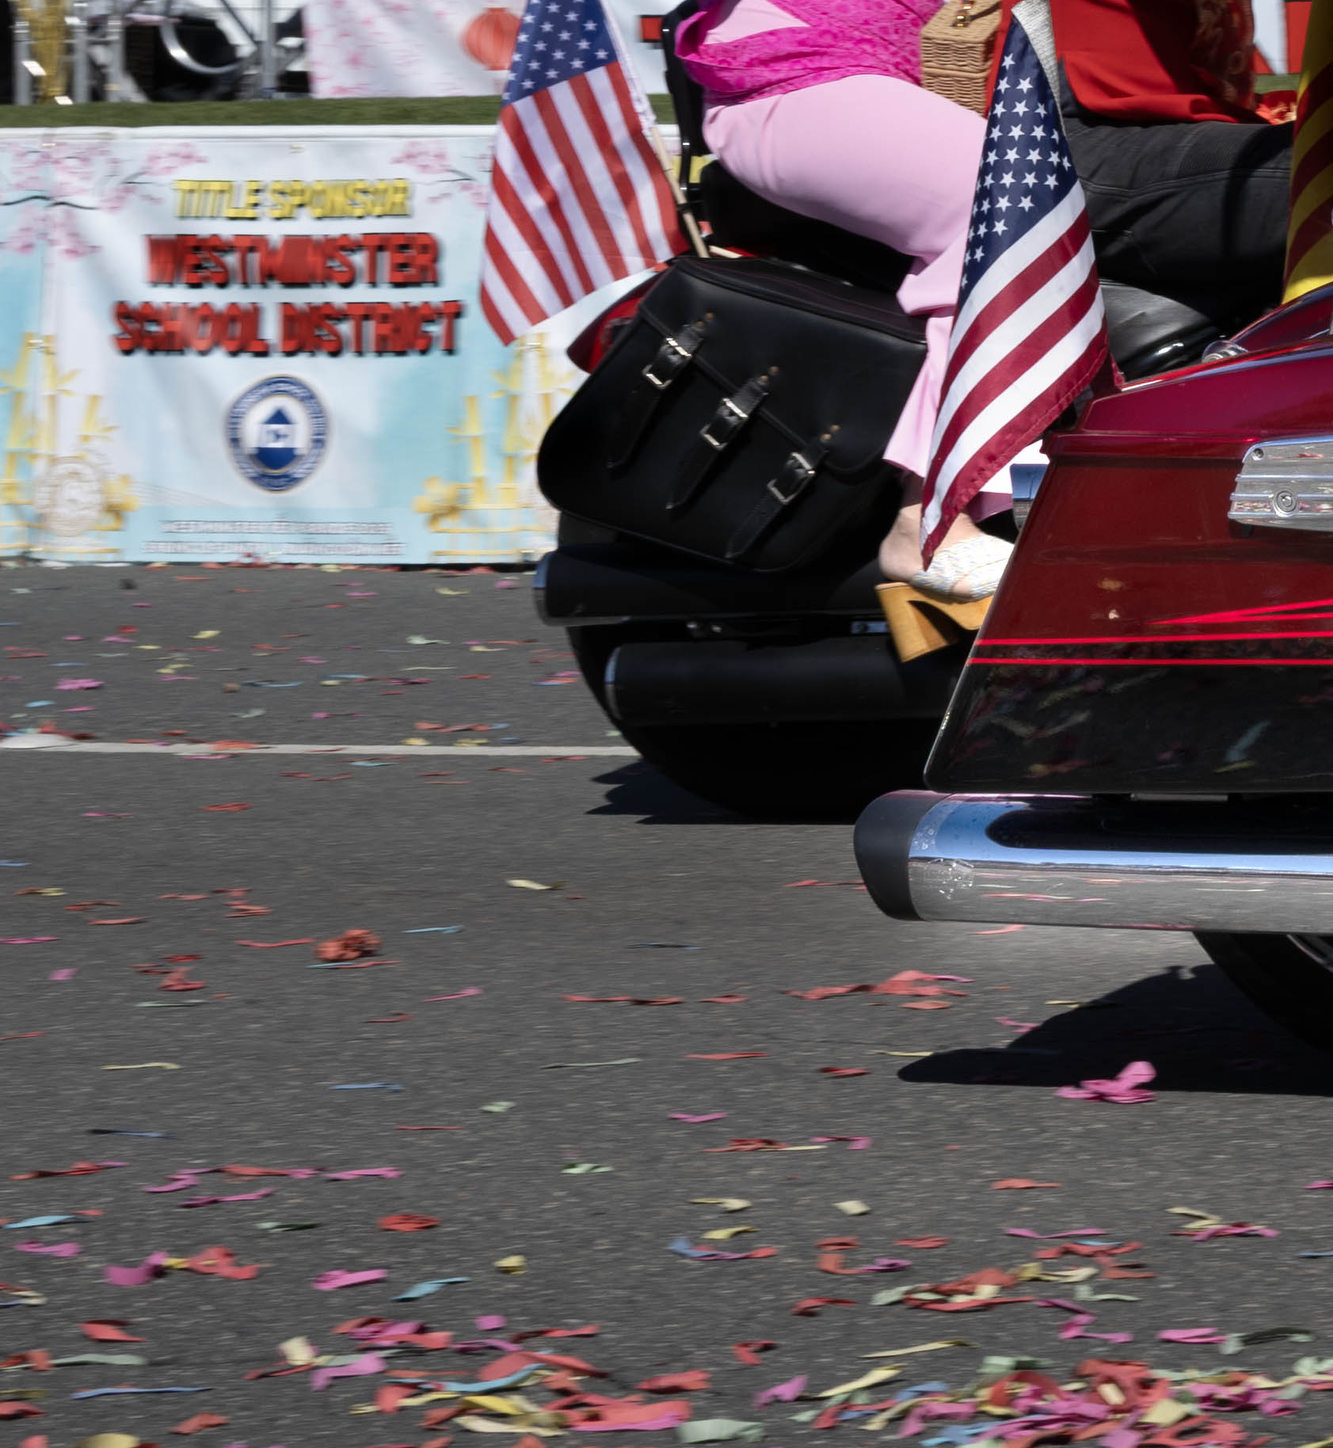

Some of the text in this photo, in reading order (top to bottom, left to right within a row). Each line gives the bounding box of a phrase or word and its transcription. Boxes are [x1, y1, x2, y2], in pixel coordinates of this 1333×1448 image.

[175, 178, 413, 219] TITLE SPONSOR
[145, 232, 442, 288] WESTMINSTER
[112, 299, 464, 357] SCHOOL DISTRICT
